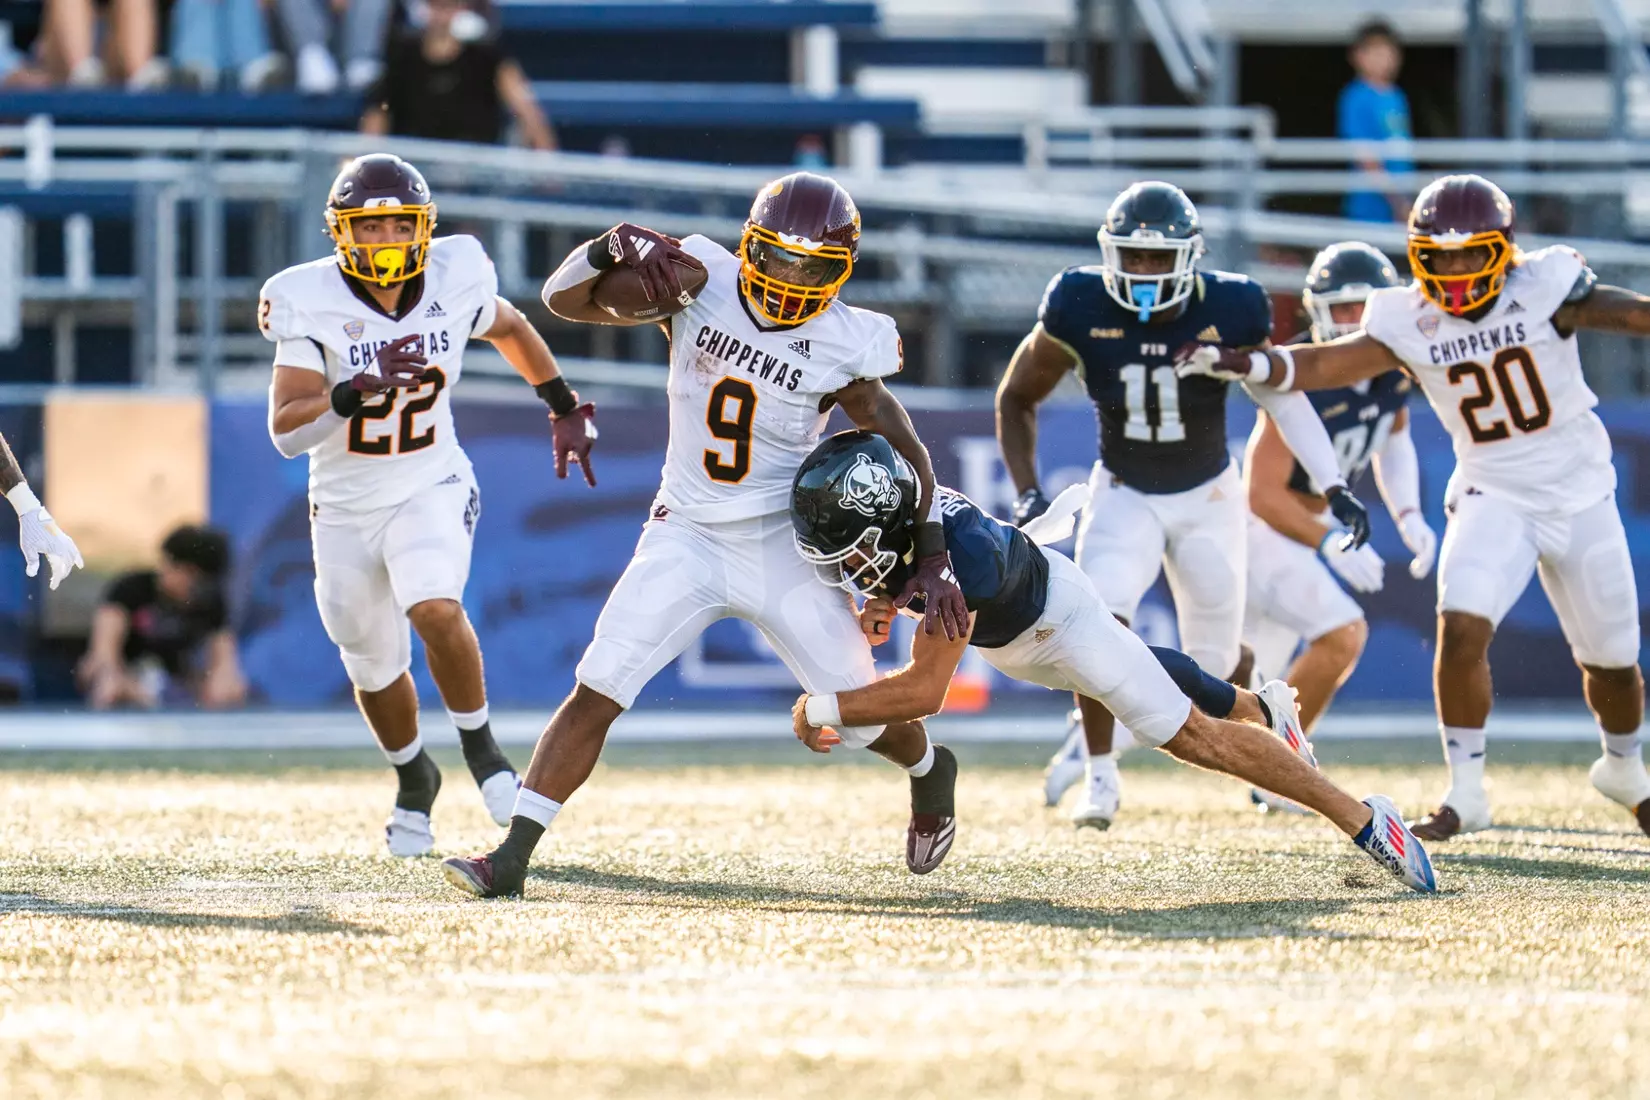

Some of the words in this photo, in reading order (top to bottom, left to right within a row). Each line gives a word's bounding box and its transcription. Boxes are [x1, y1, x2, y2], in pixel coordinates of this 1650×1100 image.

[349, 330, 450, 367] CHIWAS
[696, 325, 802, 392] CHIPPEWAS
[787, 343, 812, 360] adidas
[1430, 322, 1526, 364] CHIPPEWAS
[347, 364, 447, 457] 22
[703, 375, 758, 485] 9
[1119, 363, 1186, 442] 11
[1447, 344, 1552, 444] 20
